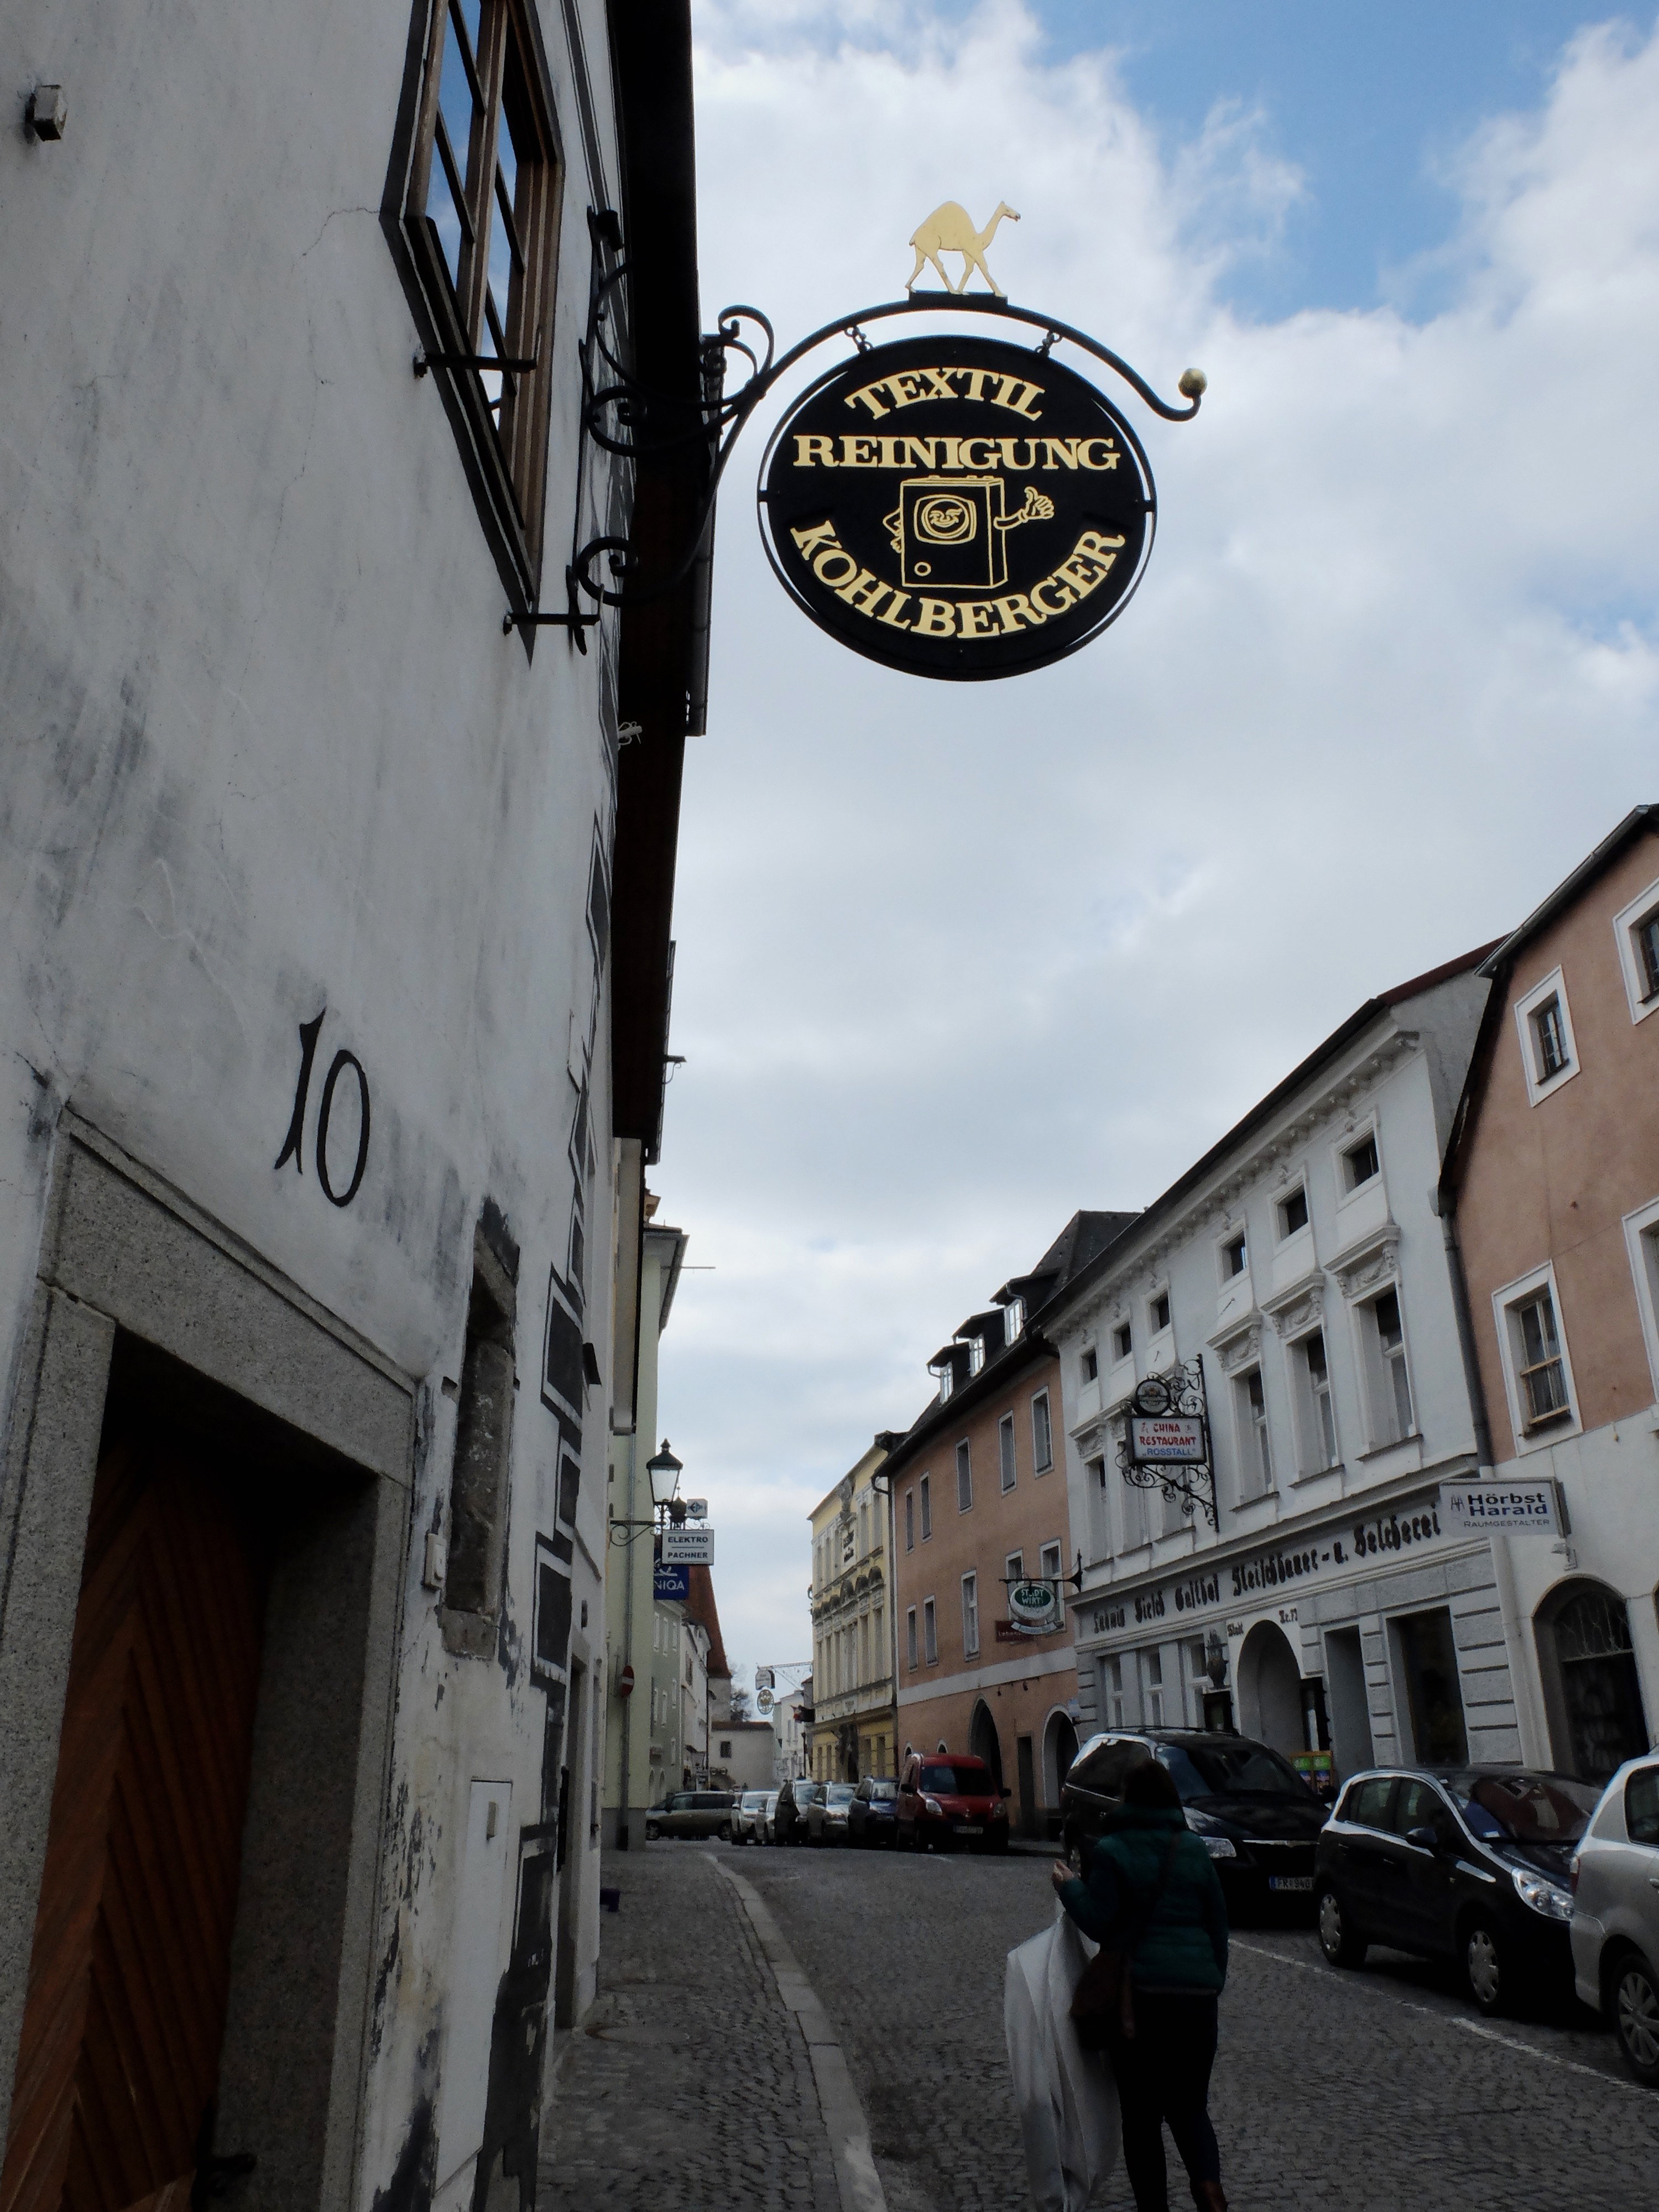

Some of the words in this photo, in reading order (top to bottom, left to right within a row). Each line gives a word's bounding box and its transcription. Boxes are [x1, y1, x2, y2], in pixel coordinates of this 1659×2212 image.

[844, 367, 1046, 421] TEXTIL
[792, 435, 1121, 469] REINIGUNG
[790, 520, 1125, 640] KOHLBERGER
[274, 1006, 370, 1208] 10
[1153, 1423, 1180, 1433] CHINA
[1139, 1436, 1196, 1446] RESTAURANT
[1468, 1493, 1546, 1505] Hörbst
[1470, 1504, 1547, 1516] Harald
[1464, 1519, 1550, 1527] RAUMGESTALTER
[1354, 1502, 1441, 1557] Selcherei
[654, 1580, 685, 1590] NIQA
